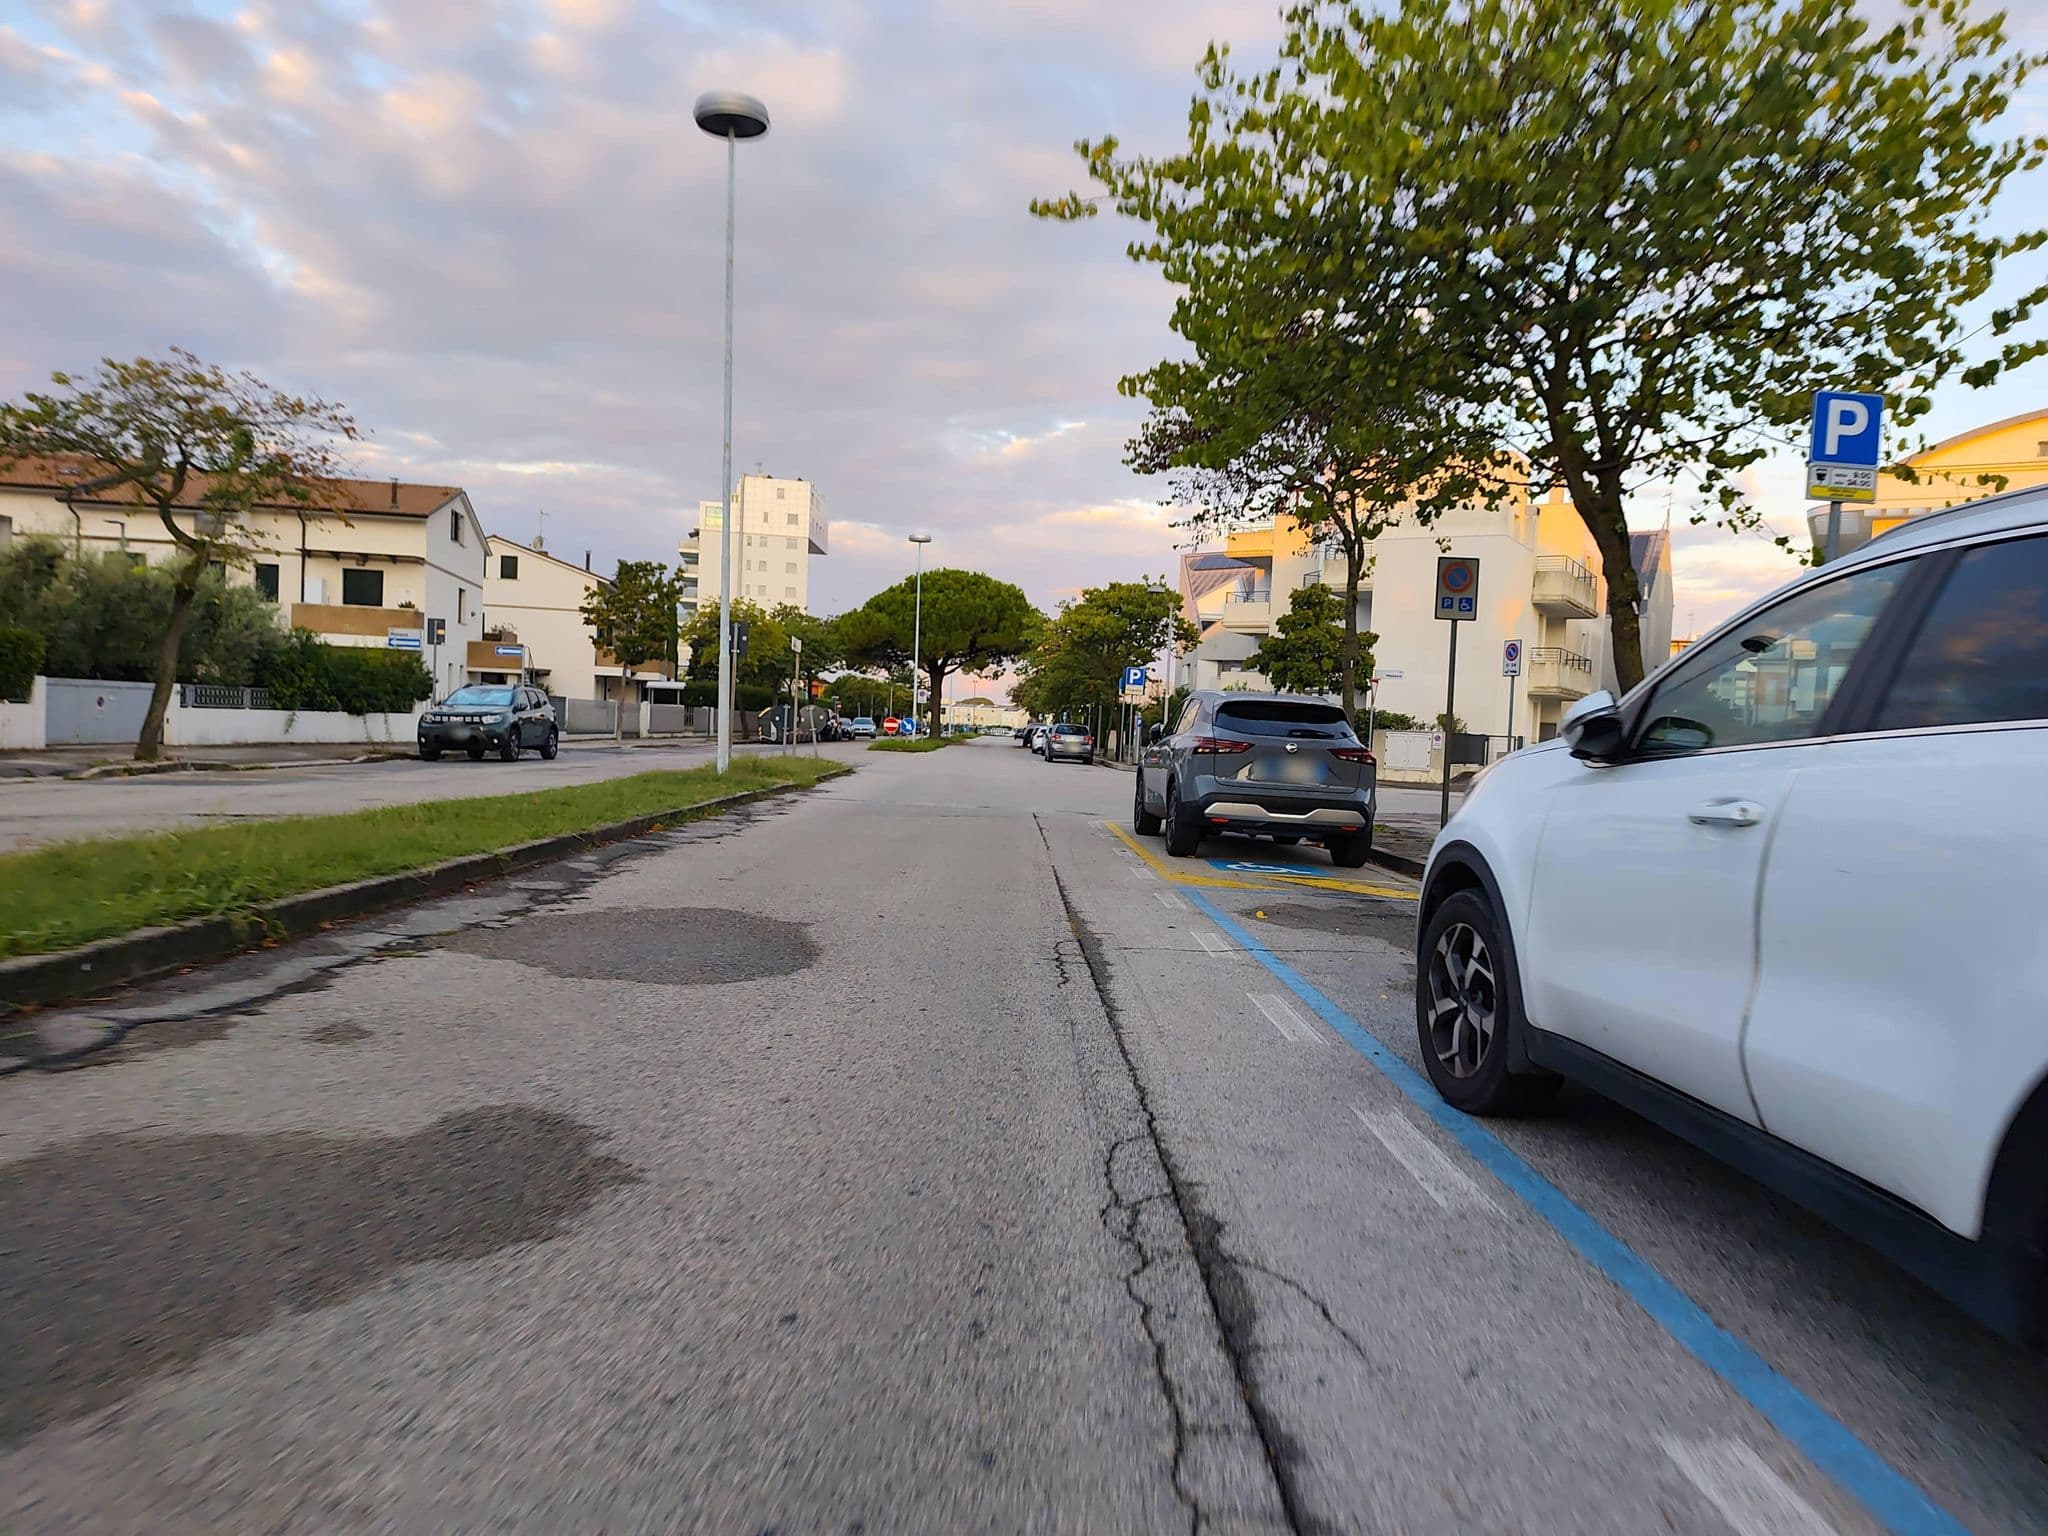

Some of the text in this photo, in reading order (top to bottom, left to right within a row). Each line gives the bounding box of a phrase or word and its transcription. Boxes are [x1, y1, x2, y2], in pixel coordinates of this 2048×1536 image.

[1825, 399, 1869, 455] P
[1444, 598, 1452, 608] P
[1129, 669, 1142, 684] P
